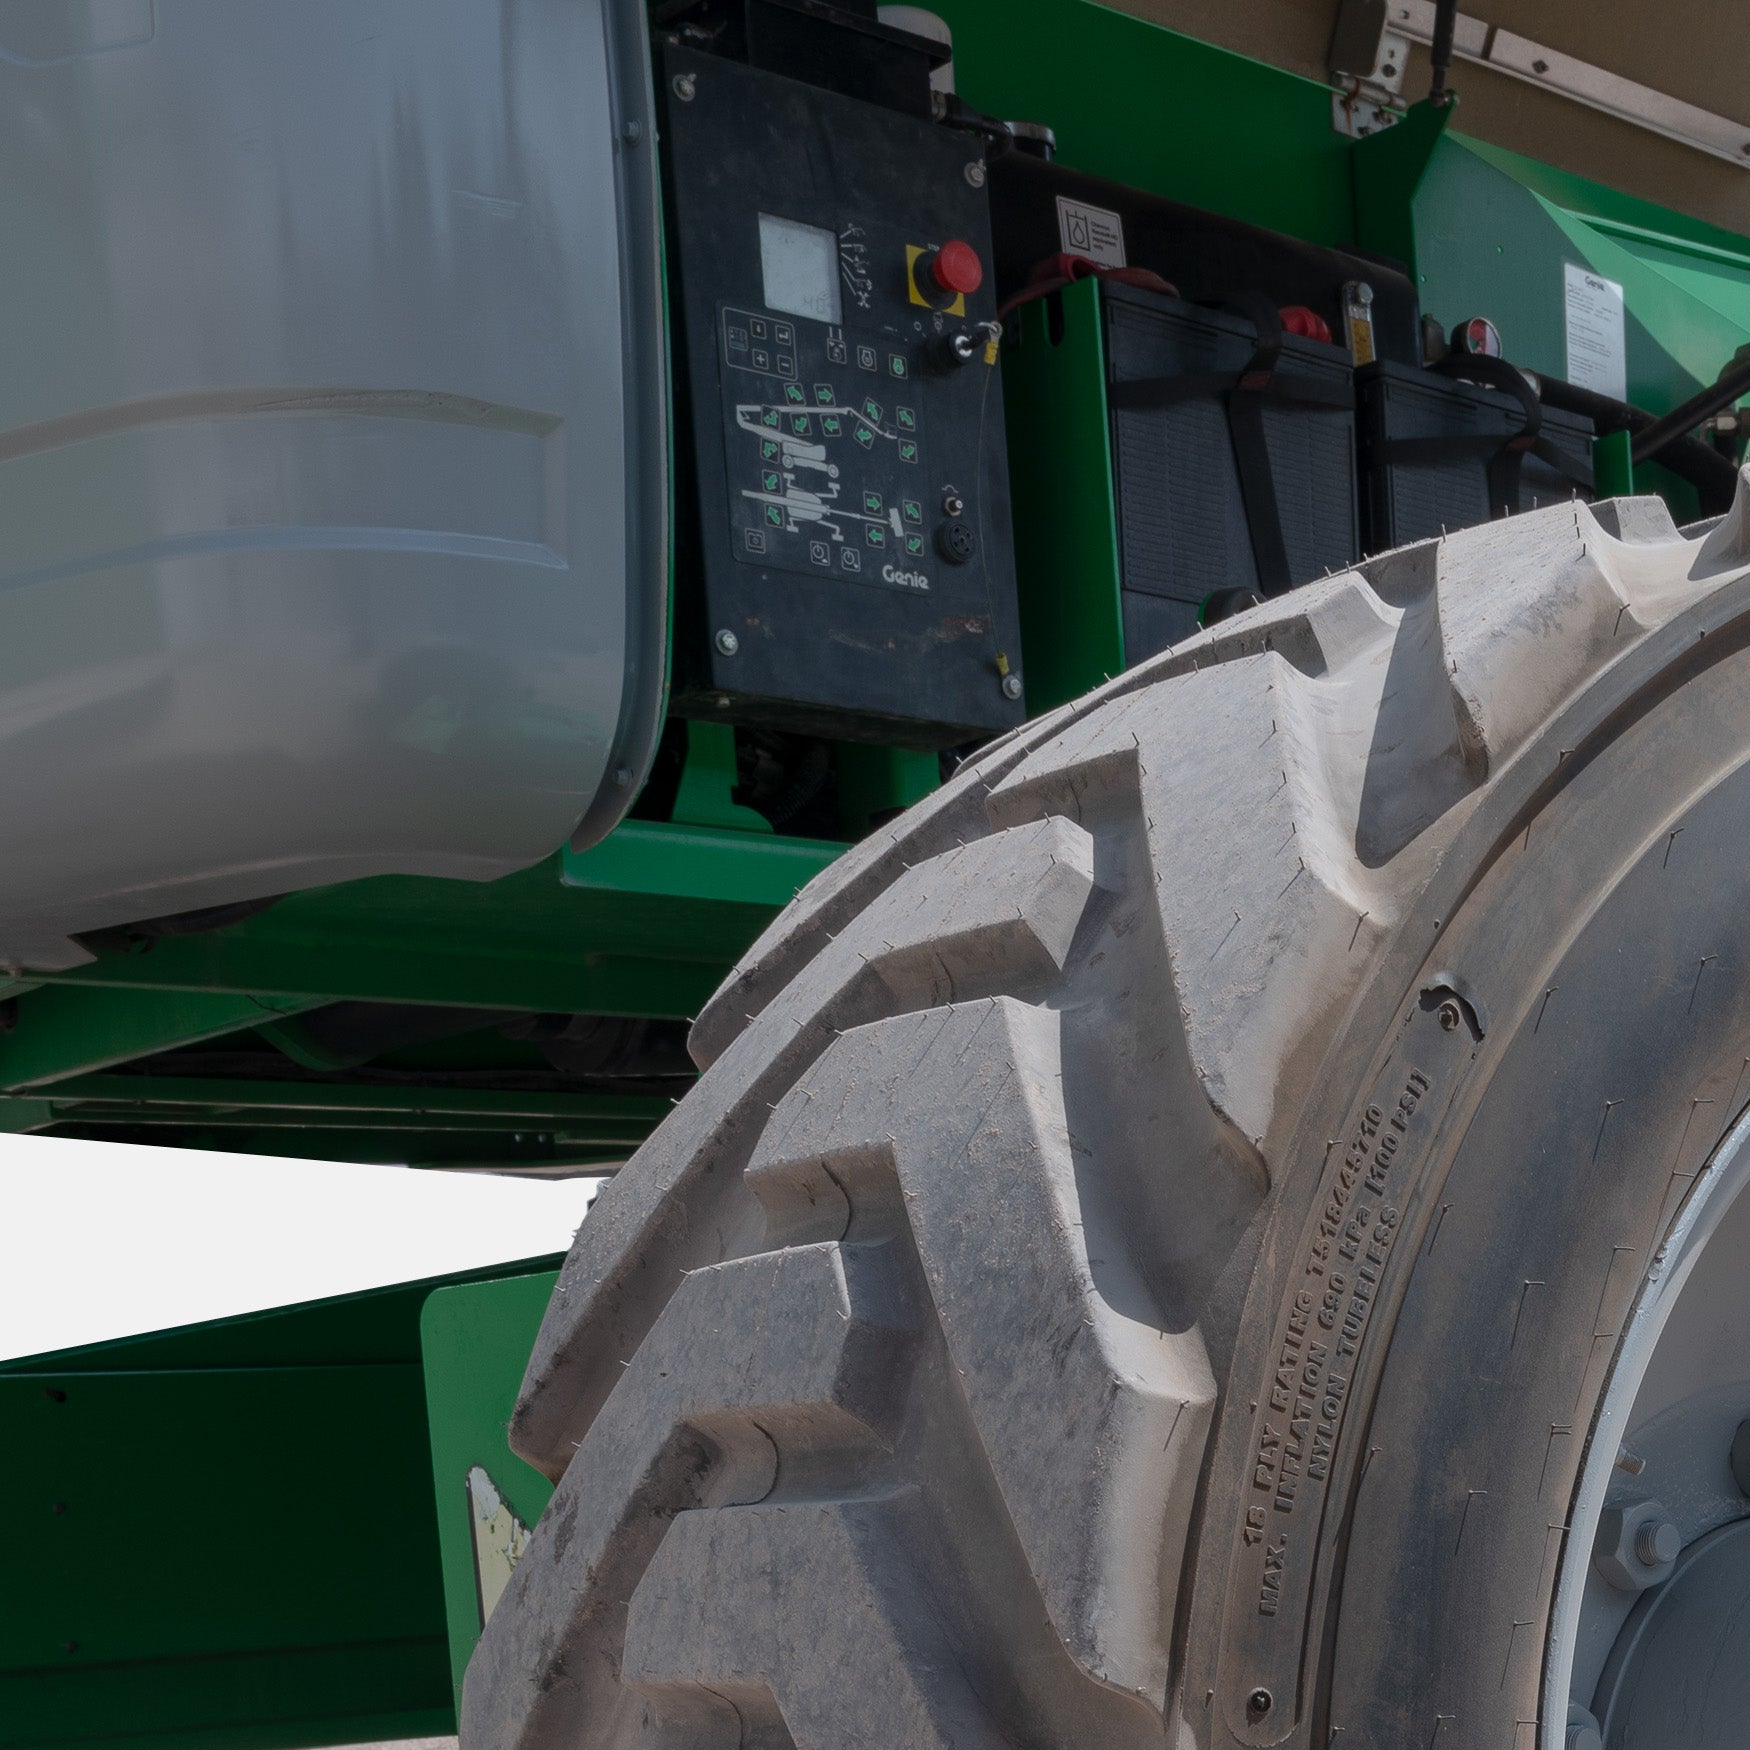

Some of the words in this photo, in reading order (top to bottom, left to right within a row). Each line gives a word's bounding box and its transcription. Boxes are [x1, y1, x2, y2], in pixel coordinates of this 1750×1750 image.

[882, 564, 930, 591] Genie
[1337, 1205, 1371, 1265] kPa
[1317, 1271, 1346, 1331] 690
[1269, 1288, 1314, 1415] RATING
[1306, 1389, 1347, 1482] NYLON
[1337, 1206, 1401, 1360] TUBELESS
[1253, 1423, 1283, 1492] PLY
[1274, 1340, 1328, 1514] INFLATION
[1243, 1504, 1269, 1547] 18
[1259, 1531, 1290, 1617] MAX.
